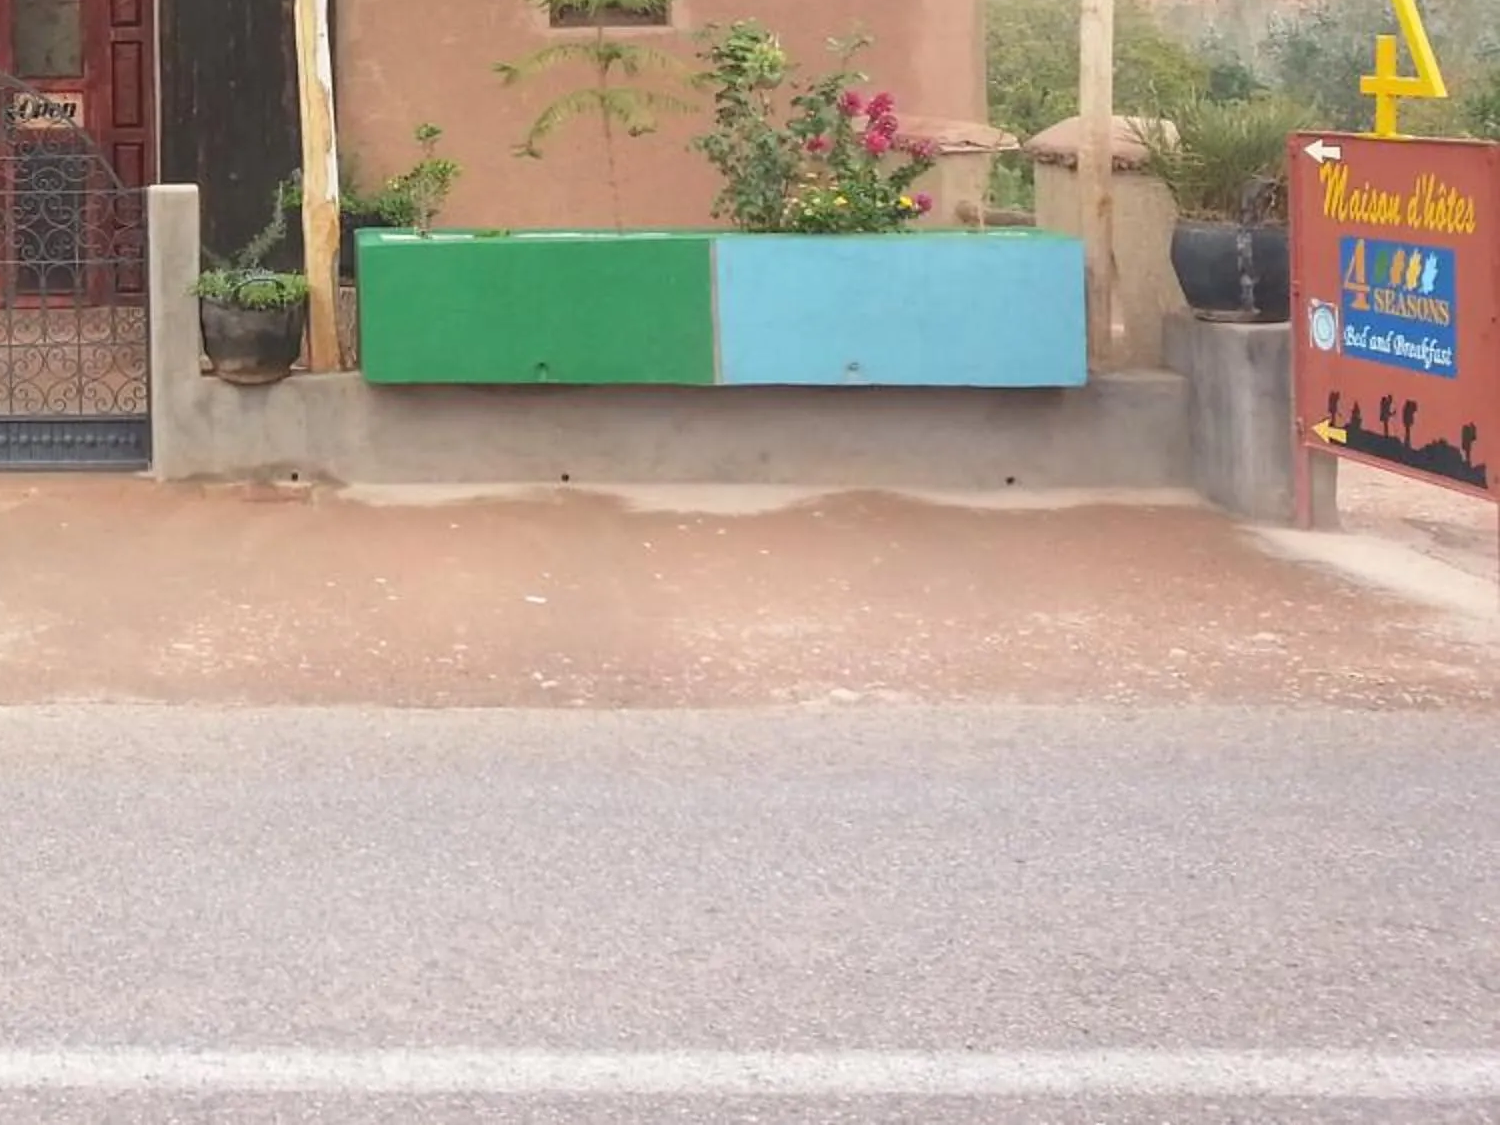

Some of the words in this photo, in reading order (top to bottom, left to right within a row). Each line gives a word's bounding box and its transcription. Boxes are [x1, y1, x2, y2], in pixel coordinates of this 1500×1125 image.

[1319, 160, 1401, 227] Maison
[1407, 172, 1476, 235] d'hôtes
[1343, 238, 1371, 311] 4
[1373, 287, 1450, 327] SEASONS
[1343, 325, 1371, 348] Bed
[1368, 331, 1395, 353] and
[1393, 333, 1454, 369] Breakfast
